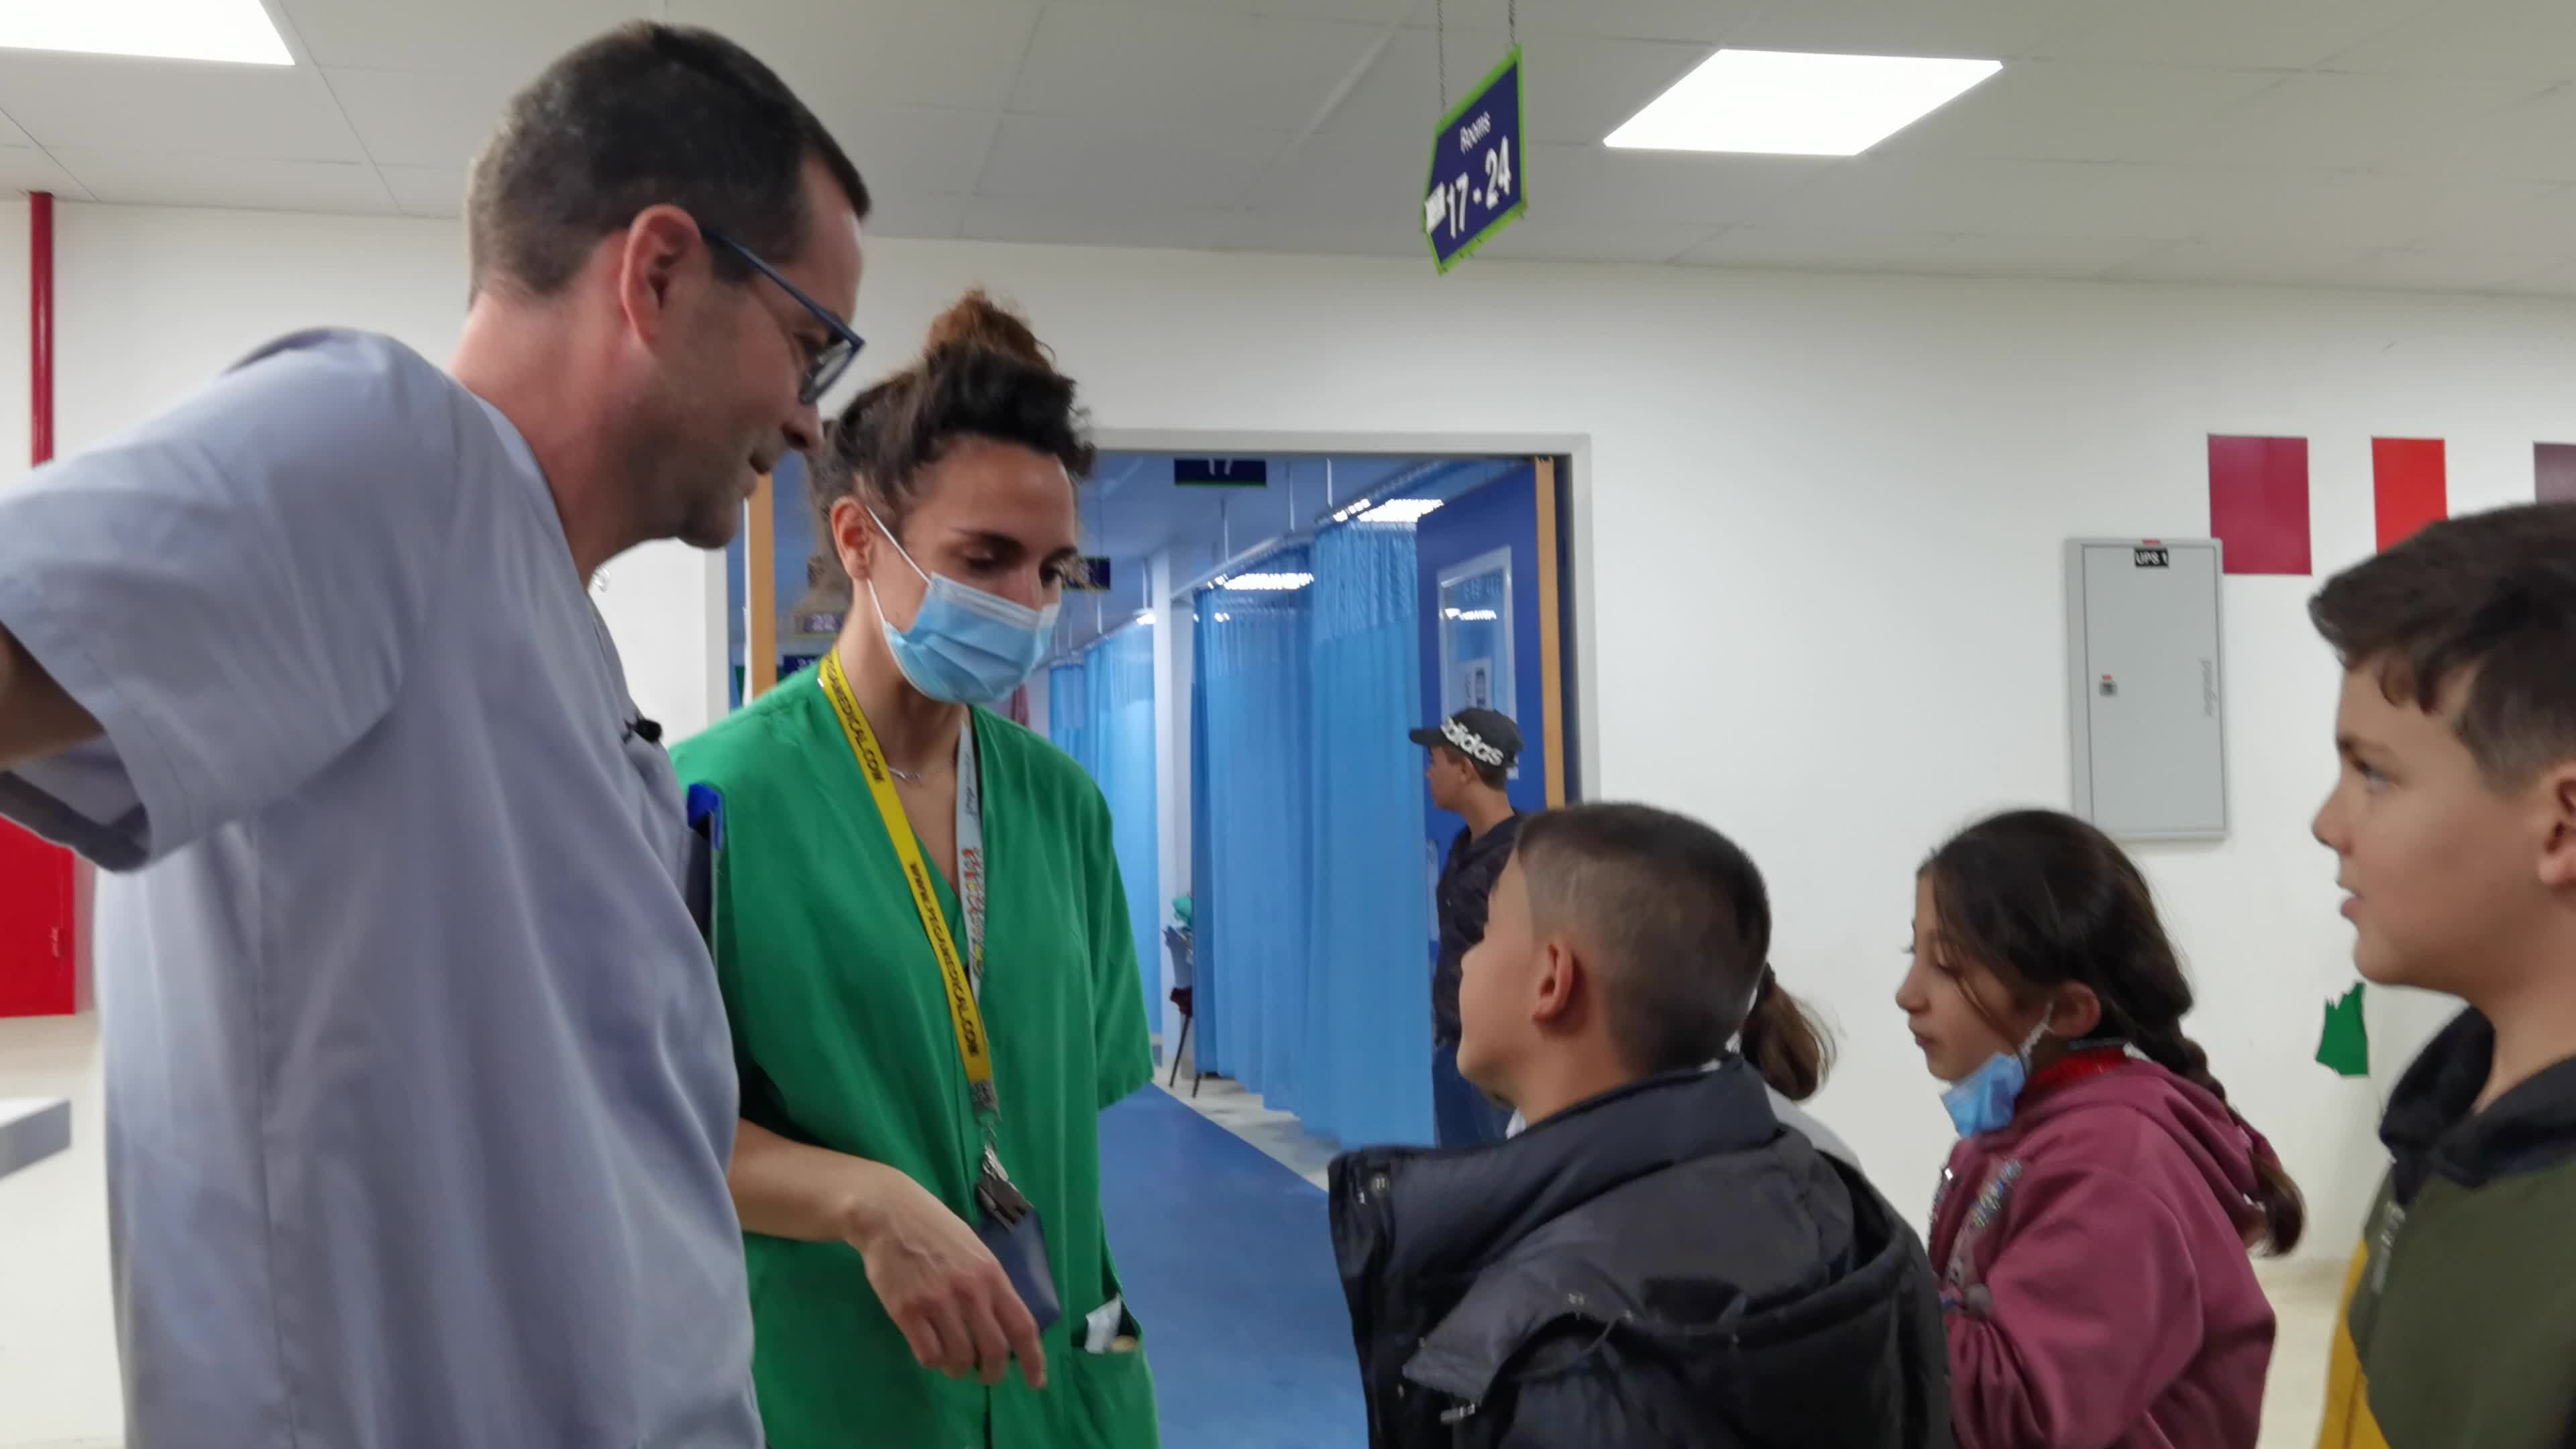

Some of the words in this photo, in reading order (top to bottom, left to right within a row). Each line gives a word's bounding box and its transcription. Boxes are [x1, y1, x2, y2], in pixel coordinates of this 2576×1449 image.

[1460, 111, 1491, 155] Rooms
[1446, 172, 1469, 239] 17
[1485, 135, 1511, 211] 24
[2135, 551, 2160, 565] UPS
